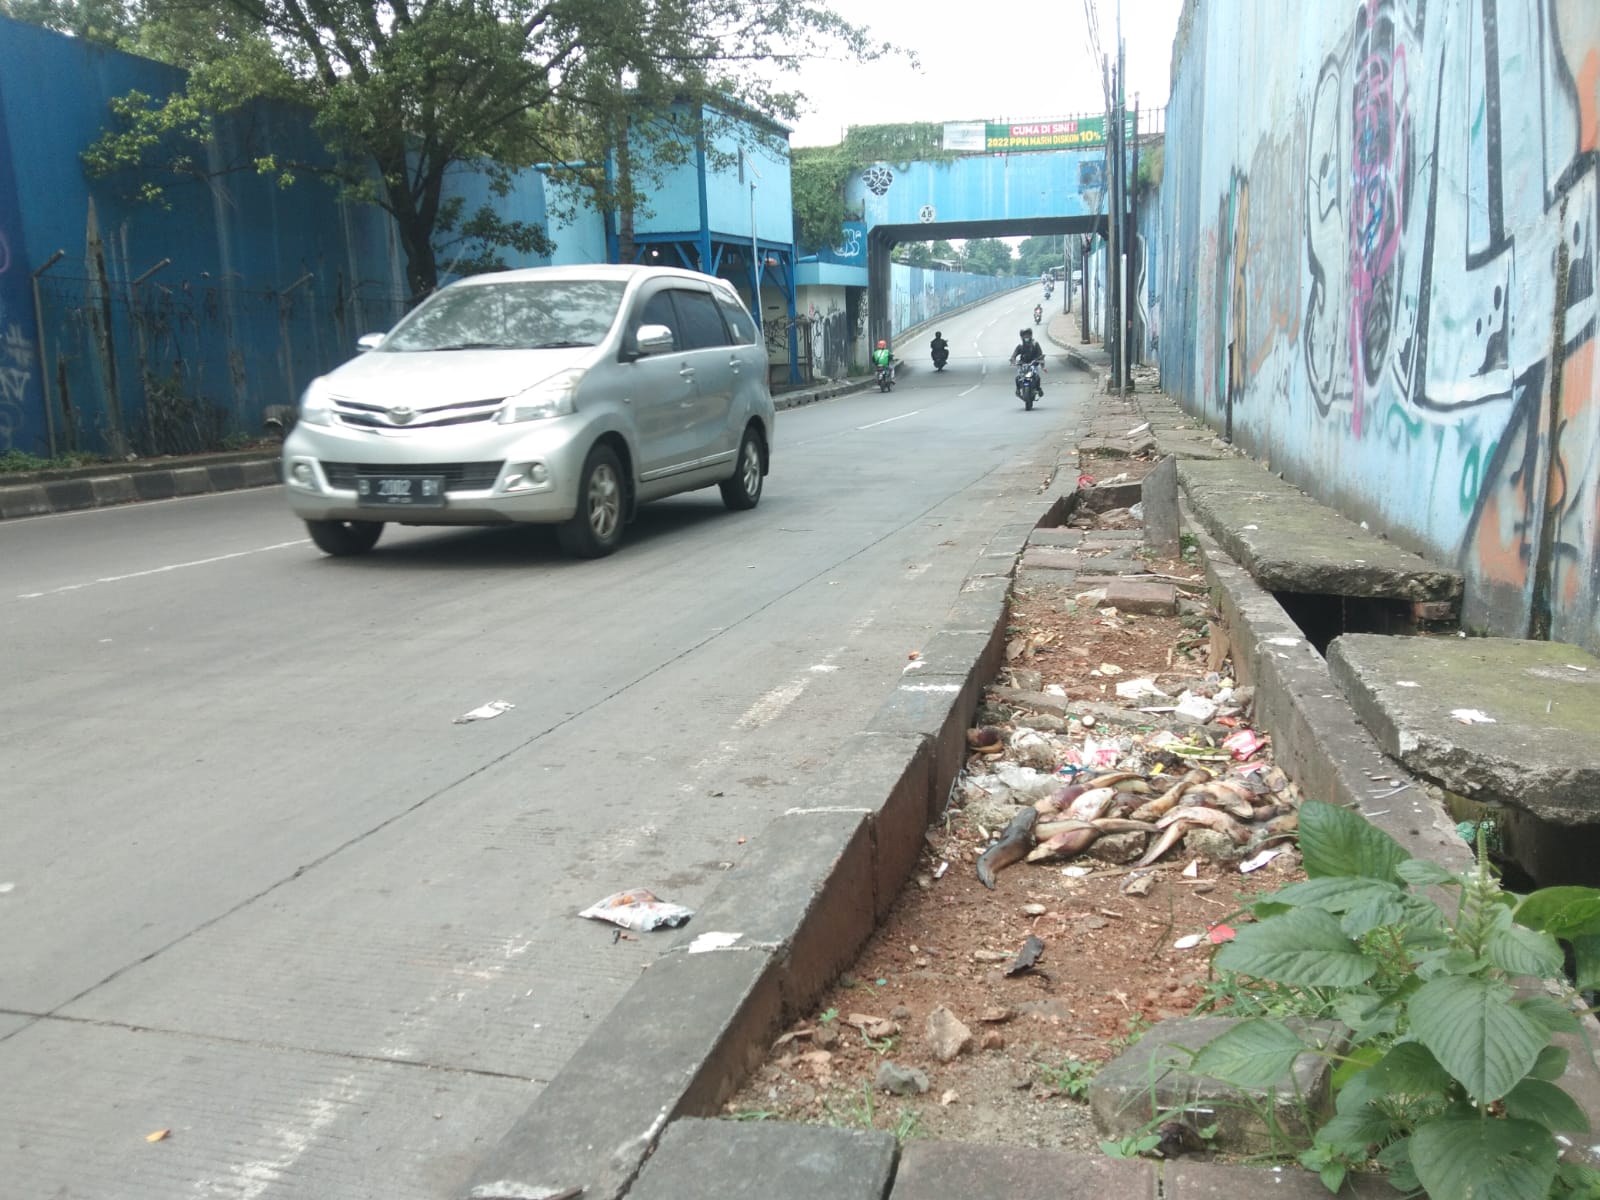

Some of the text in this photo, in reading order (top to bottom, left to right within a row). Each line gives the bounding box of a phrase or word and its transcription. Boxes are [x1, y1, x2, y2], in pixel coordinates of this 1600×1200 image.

[1012, 125, 1040, 136] CUMA
[1041, 124, 1051, 134] DI
[987, 137, 1009, 148] 2022
[1010, 136, 1029, 147] PPN
[1053, 134, 1079, 145] DISKON
